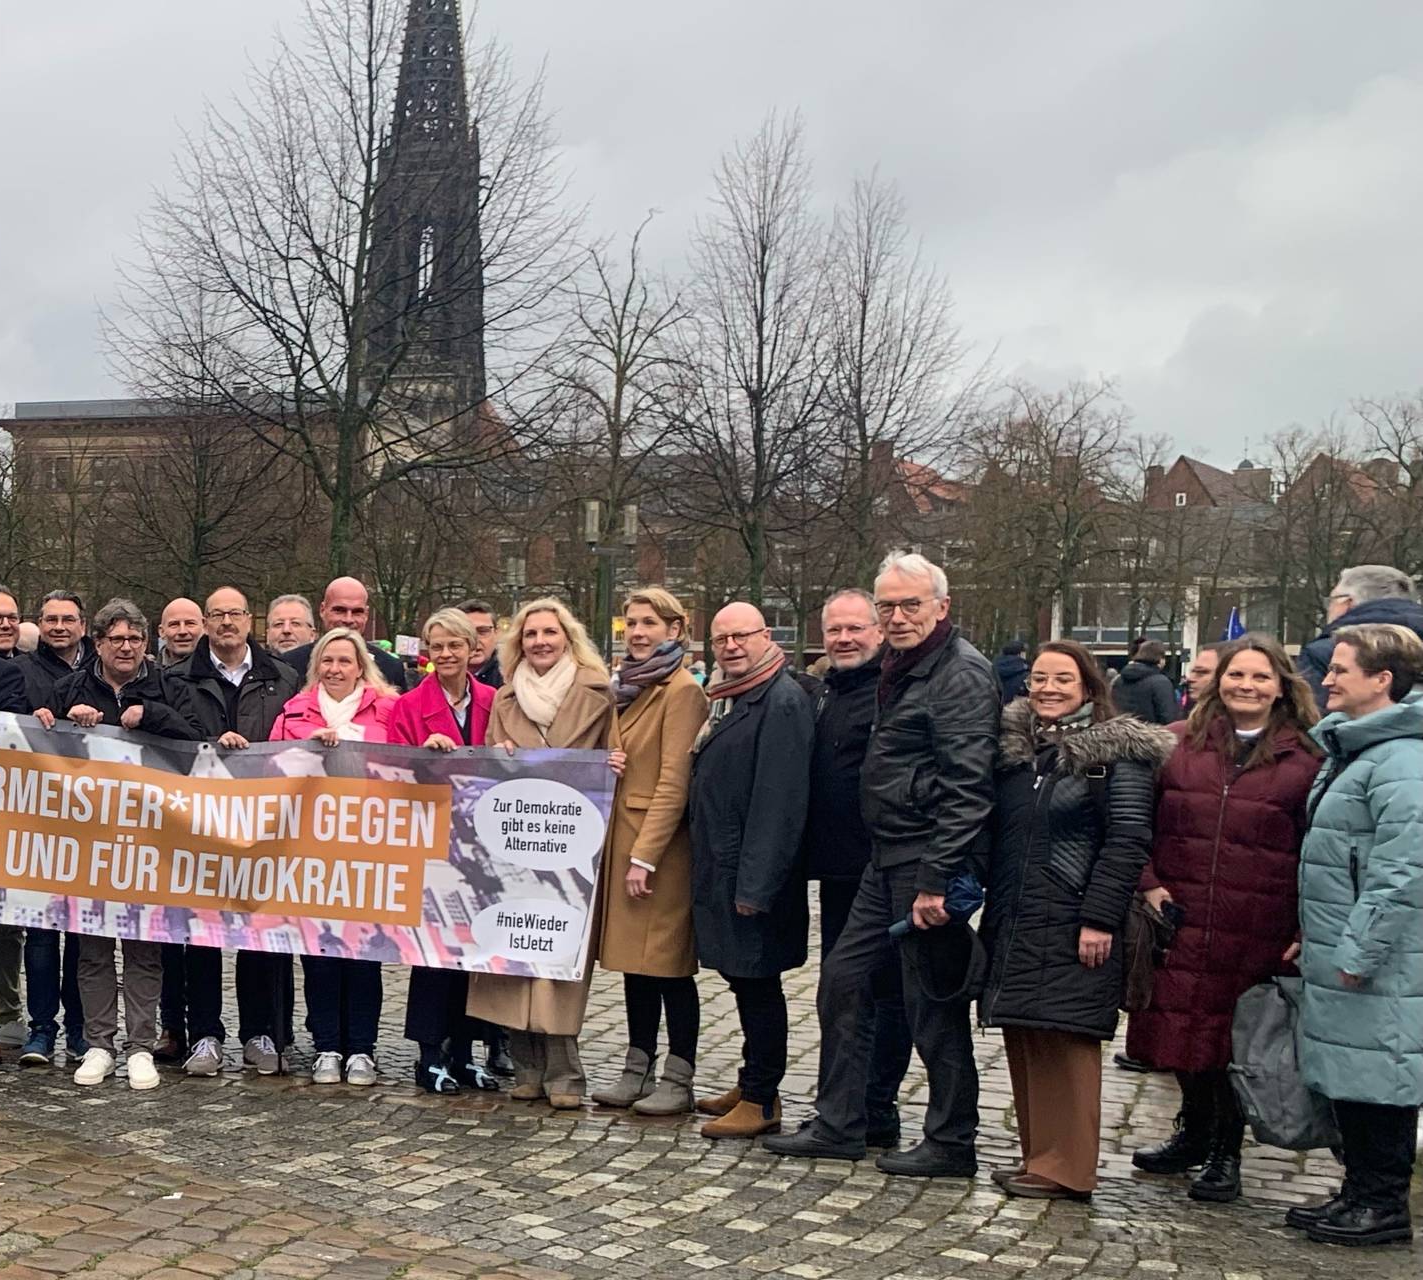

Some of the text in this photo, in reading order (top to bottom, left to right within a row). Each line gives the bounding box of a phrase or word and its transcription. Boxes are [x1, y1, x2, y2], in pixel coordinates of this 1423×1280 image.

[493, 798, 582, 816] Zur Demokratie
[313, 793, 435, 848] GEGEN
[501, 817, 576, 835] gibt es keine
[505, 836, 567, 853] Alternative
[4, 830, 80, 882] UND
[89, 835, 159, 892] FÜR
[170, 849, 409, 912] DEMOKRATIE
[496, 911, 569, 932] #nieWieder
[509, 933, 554, 952] IstJetzt
